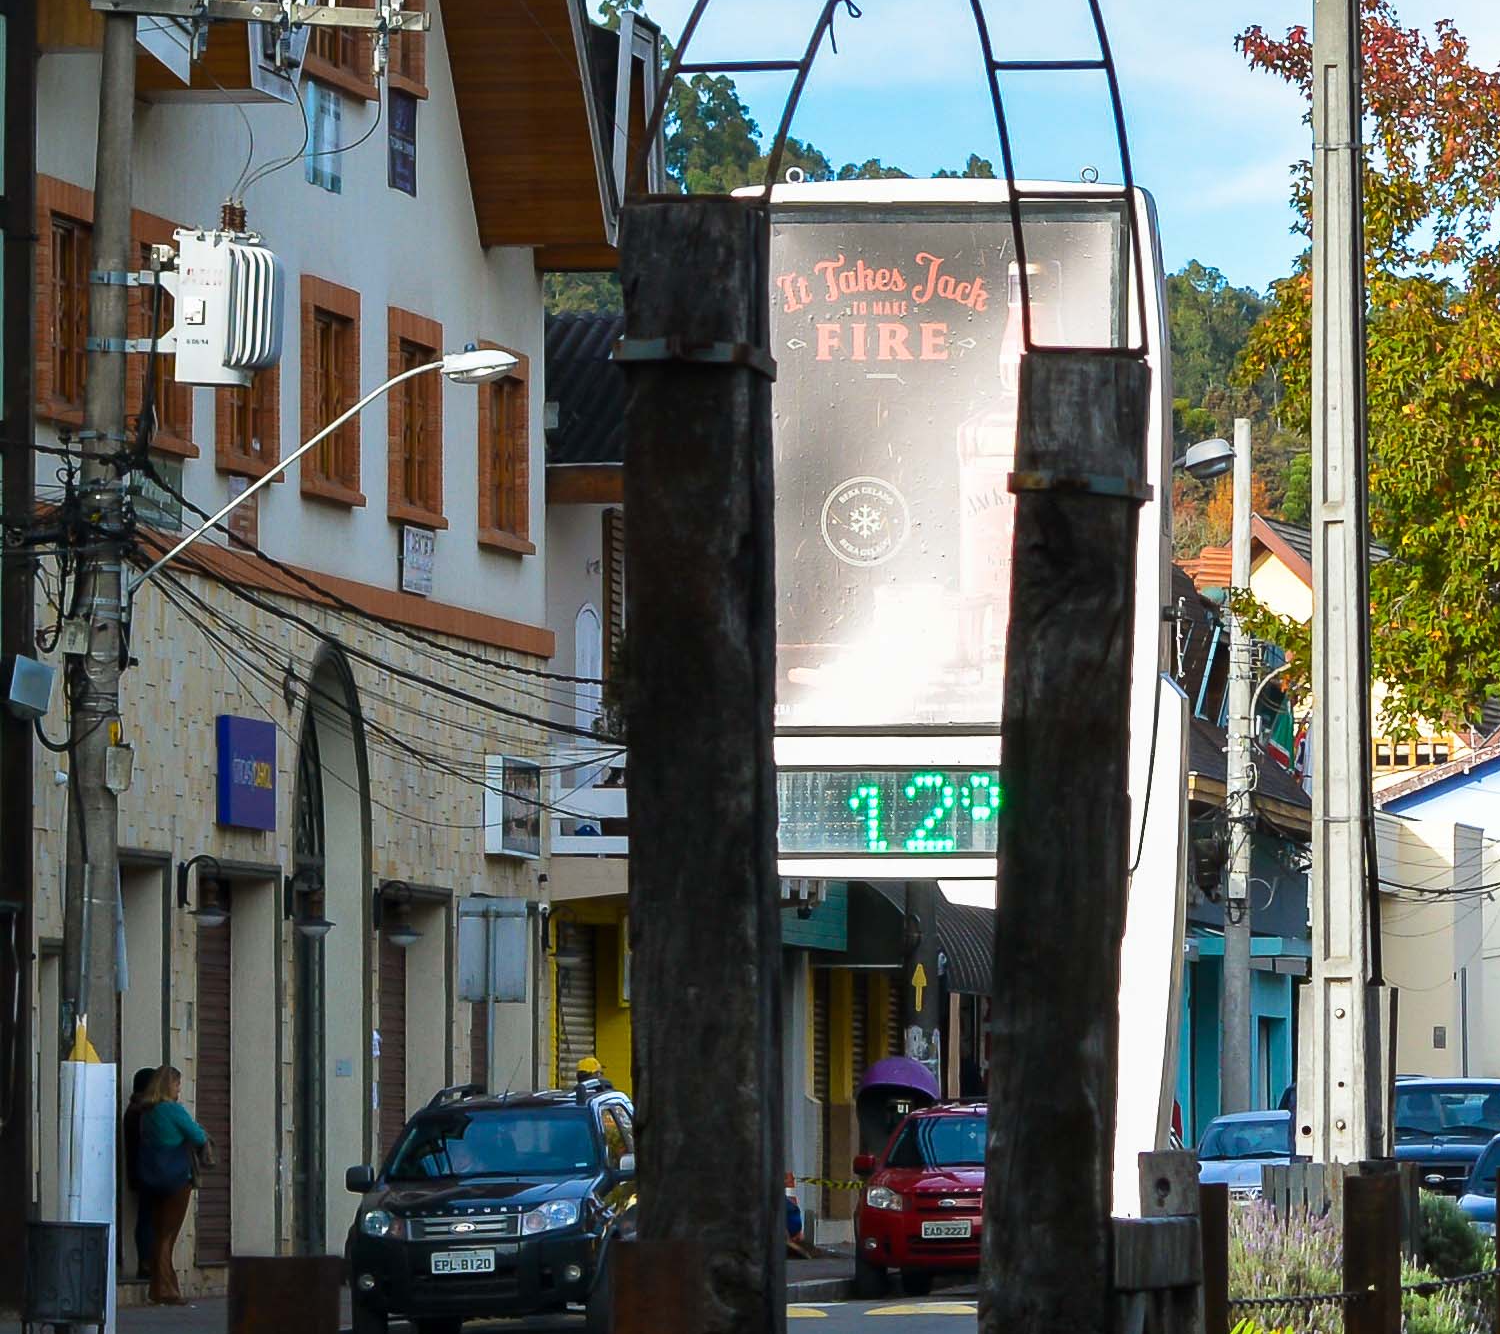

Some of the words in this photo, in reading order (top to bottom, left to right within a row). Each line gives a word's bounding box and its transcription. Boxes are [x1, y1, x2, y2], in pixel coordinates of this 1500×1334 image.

[776, 272, 813, 313] It
[813, 253, 907, 302] Takes
[912, 251, 989, 312] Jack
[852, 301, 867, 315] TO
[873, 301, 907, 315] MAKE
[815, 322, 949, 361] FIRE
